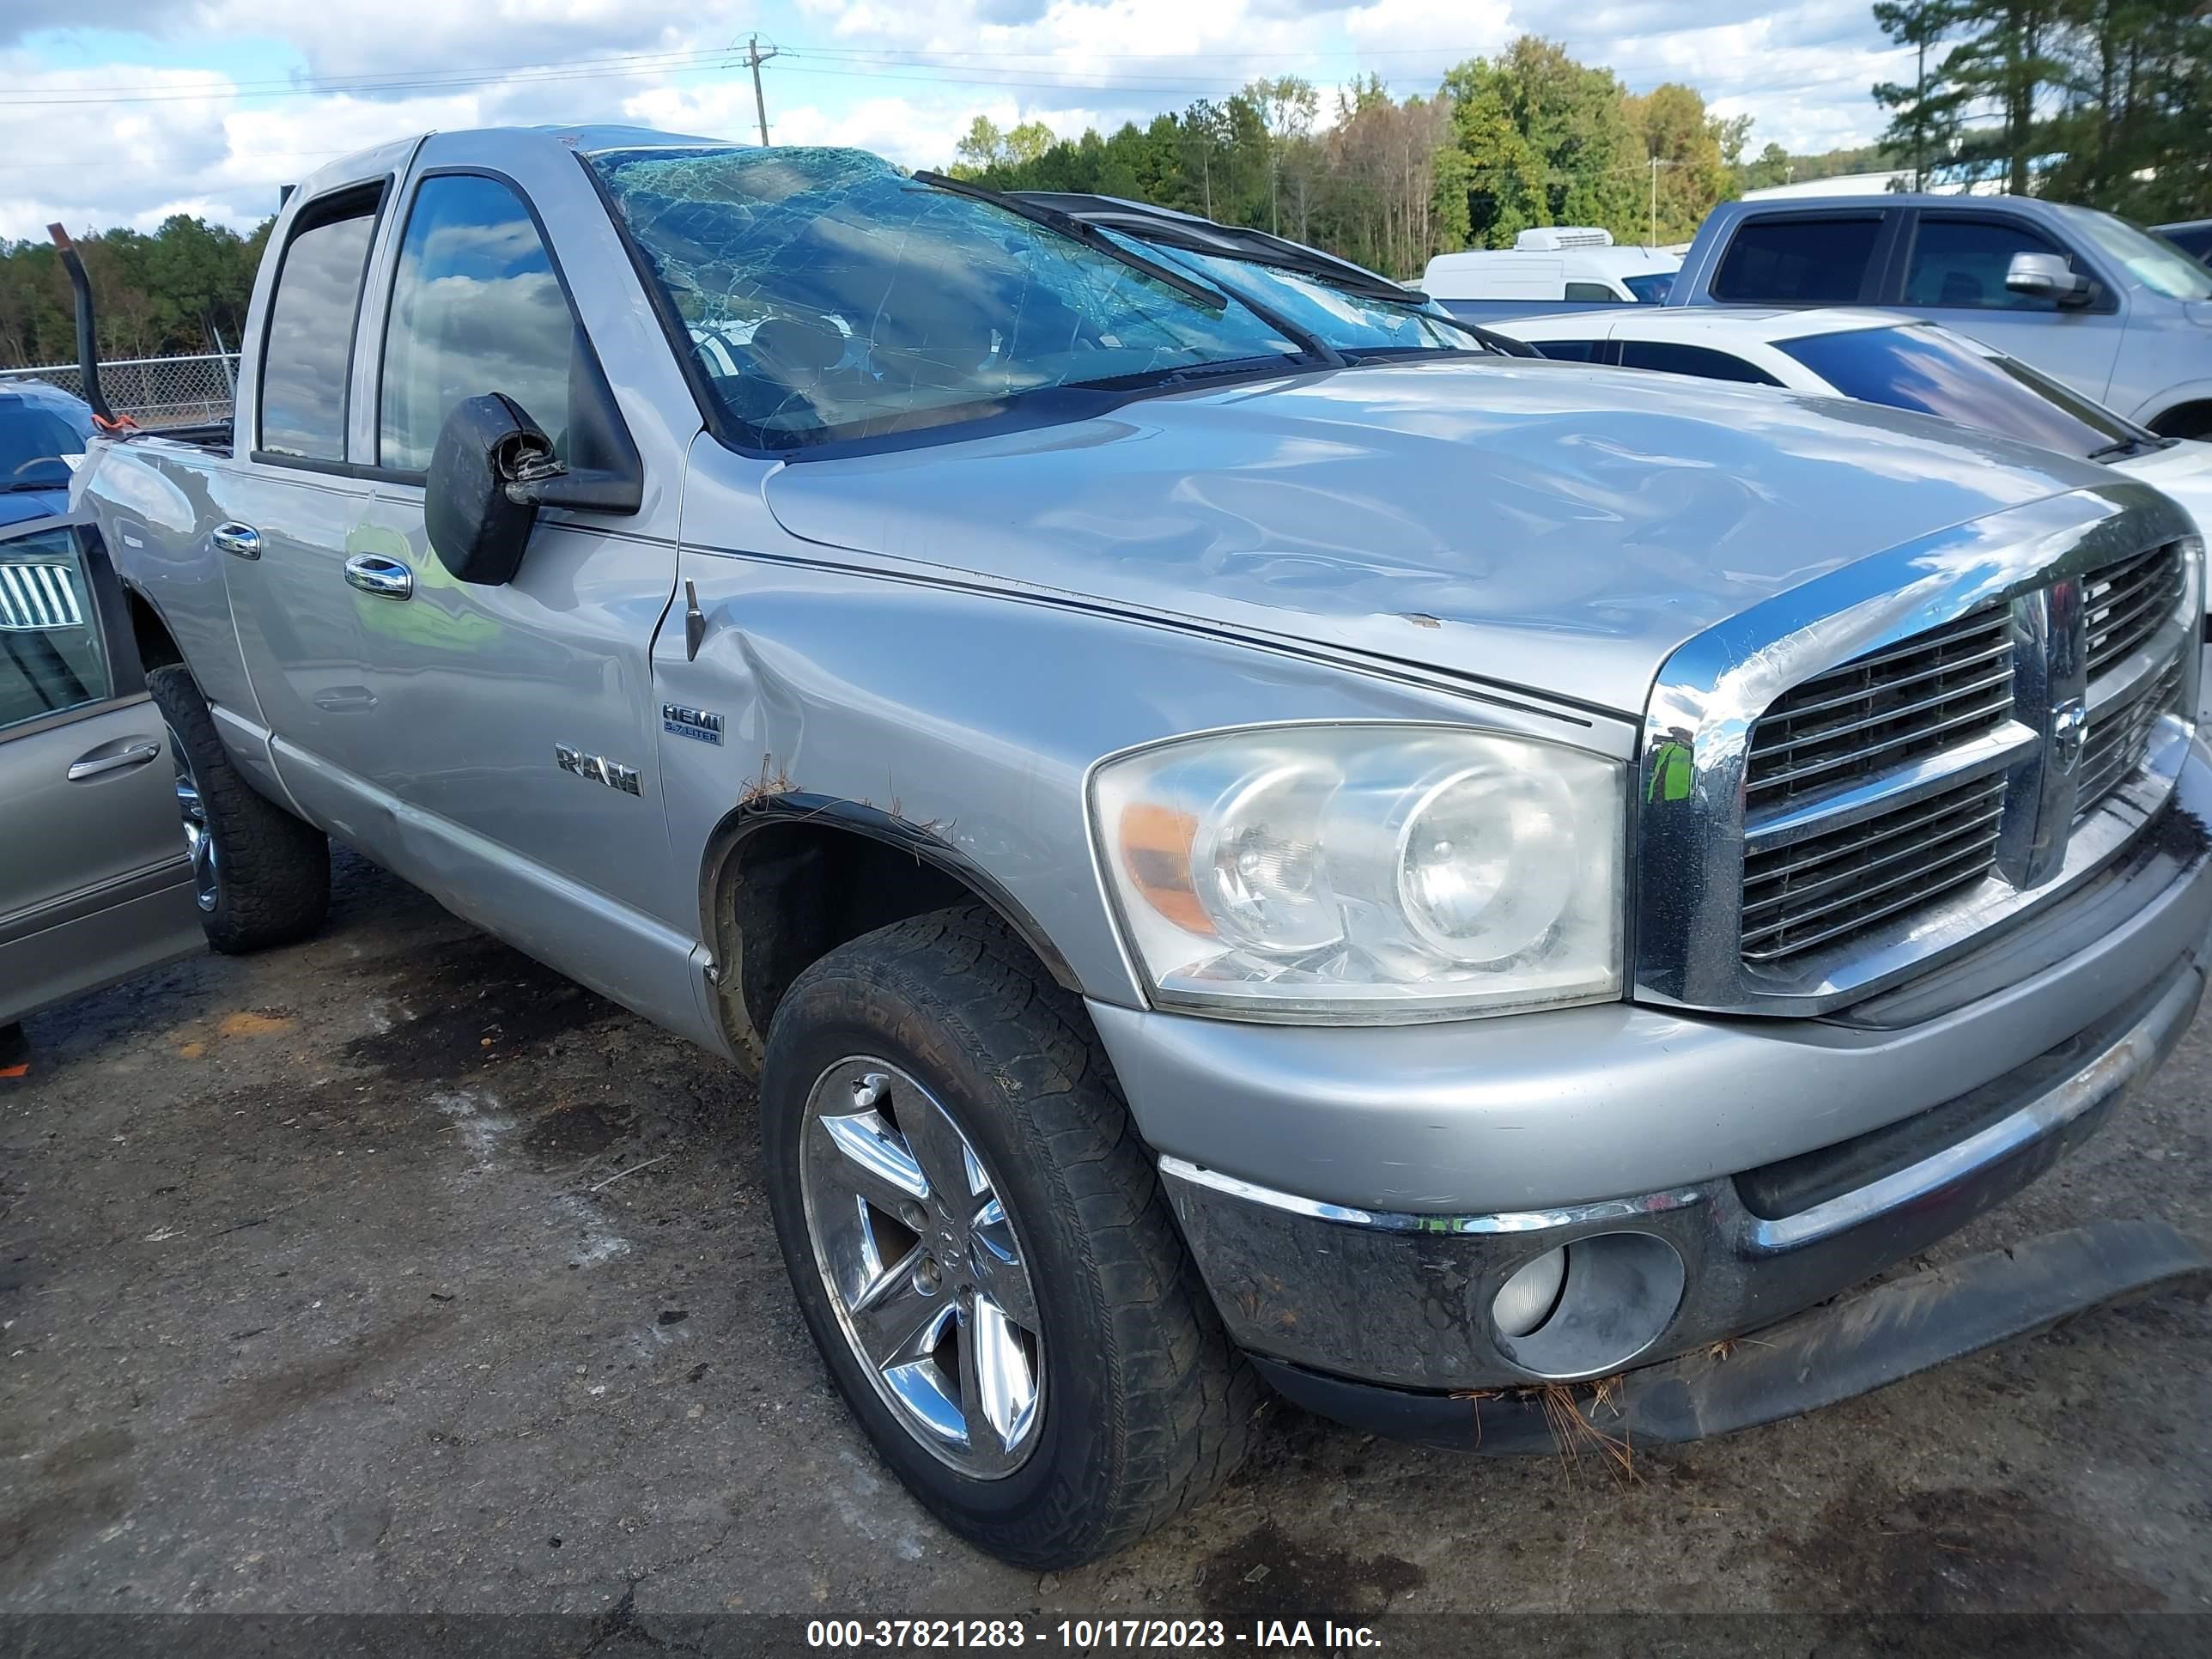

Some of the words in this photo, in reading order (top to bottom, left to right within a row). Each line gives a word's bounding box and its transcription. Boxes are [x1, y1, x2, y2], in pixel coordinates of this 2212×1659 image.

[663, 703, 721, 732] HEMI
[665, 721, 683, 734] 5.7
[685, 726, 718, 743] LITER
[555, 742, 645, 798] RAM
